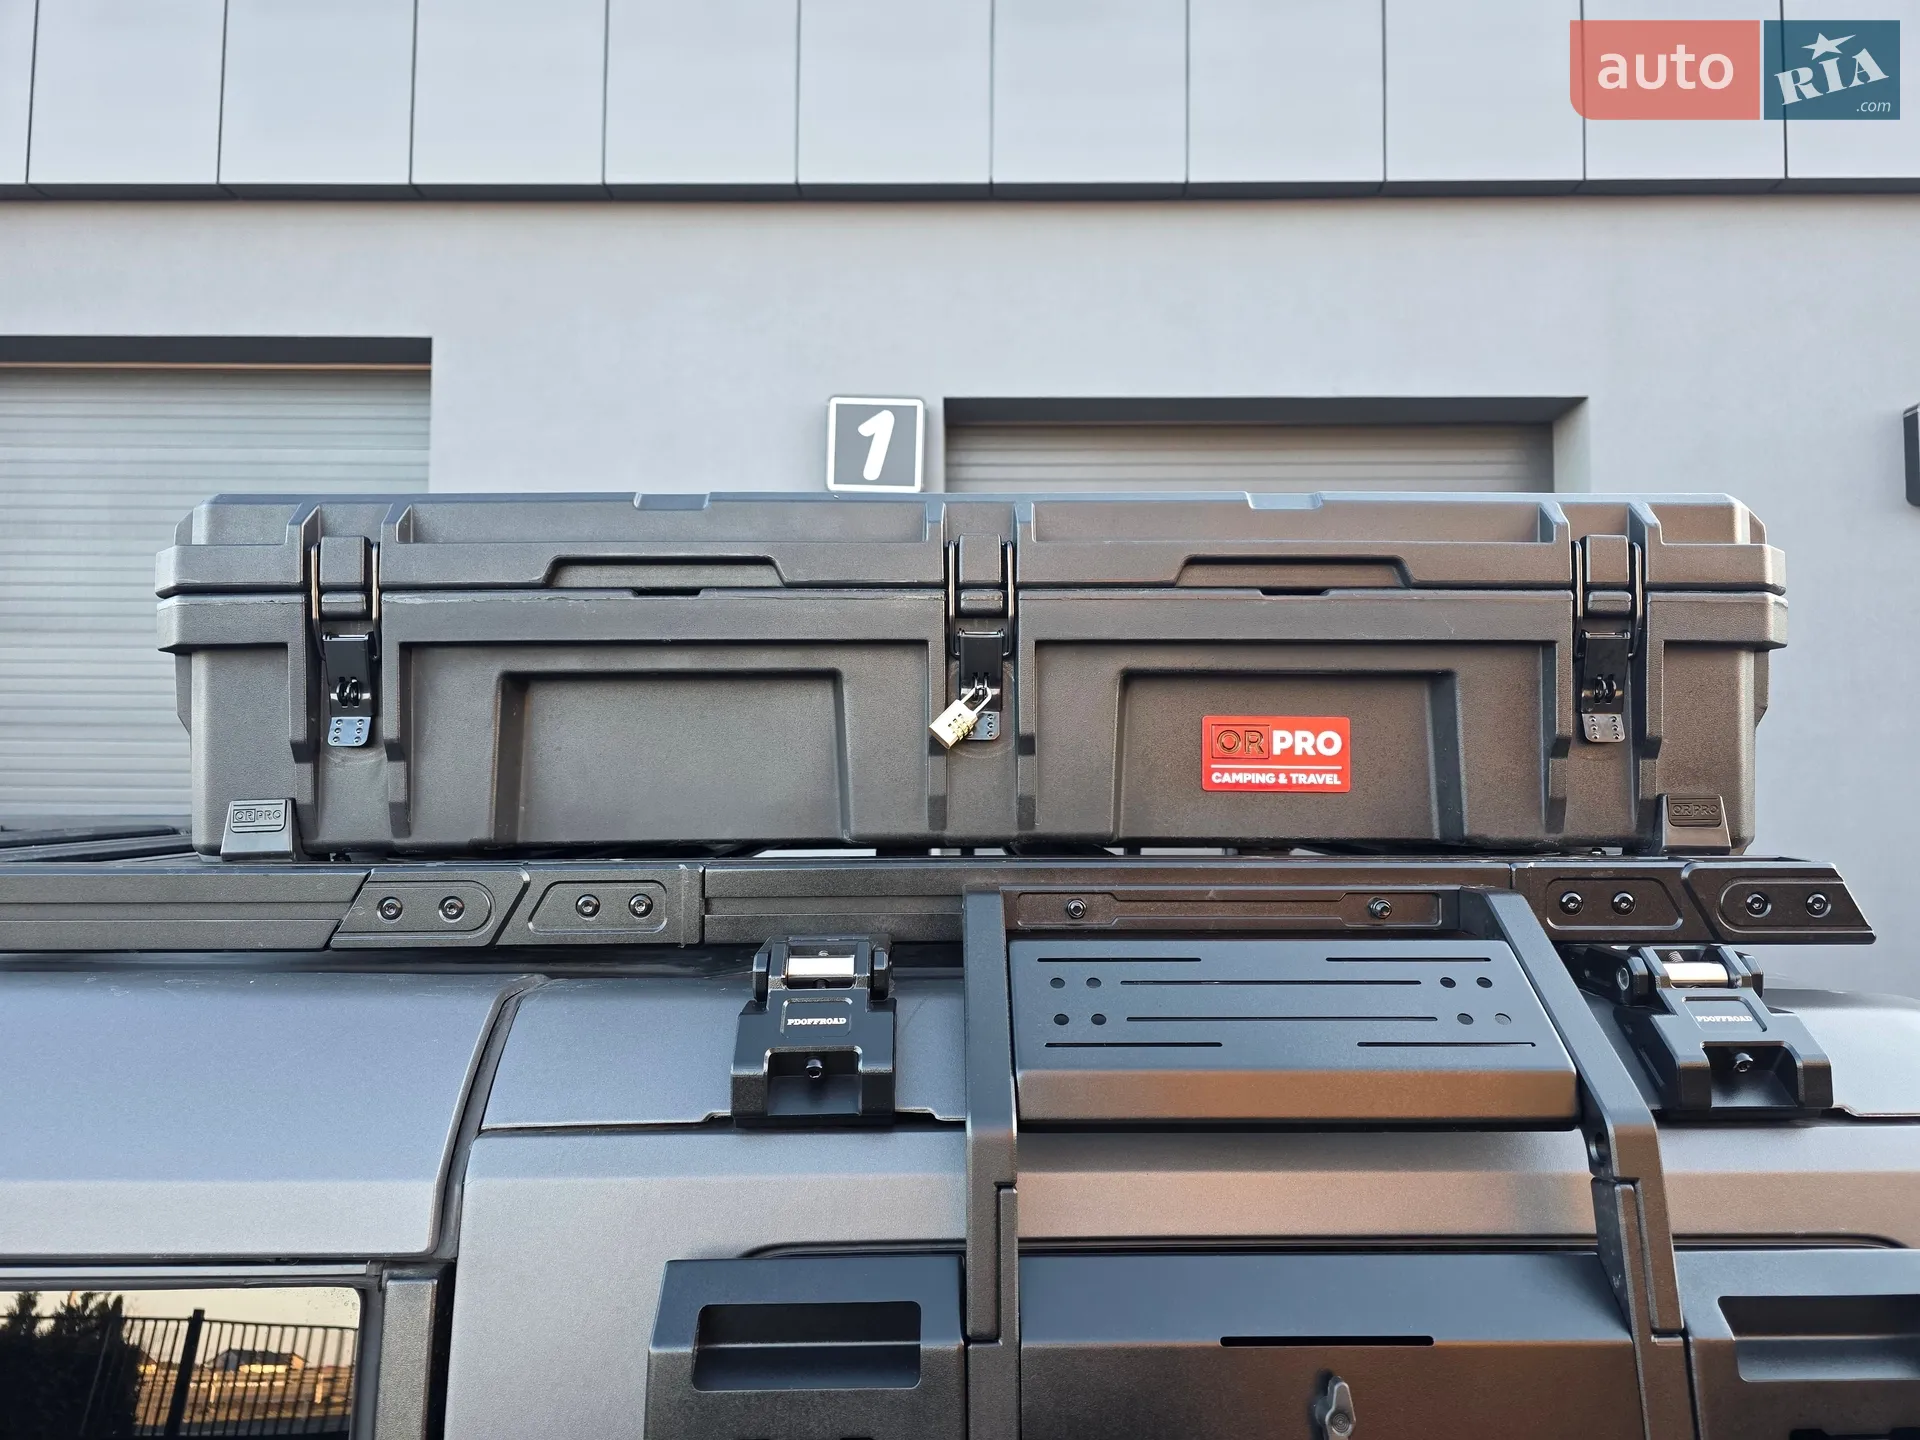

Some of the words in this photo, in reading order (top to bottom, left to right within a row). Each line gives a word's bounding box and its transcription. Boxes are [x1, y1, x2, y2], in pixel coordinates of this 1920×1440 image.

[857, 409, 895, 481] 1
[1211, 772, 1276, 784] CAMPING
[1278, 772, 1288, 784] &
[1290, 773, 1342, 785] TRAVEL
[787, 1018, 847, 1026] PDOFFROAD
